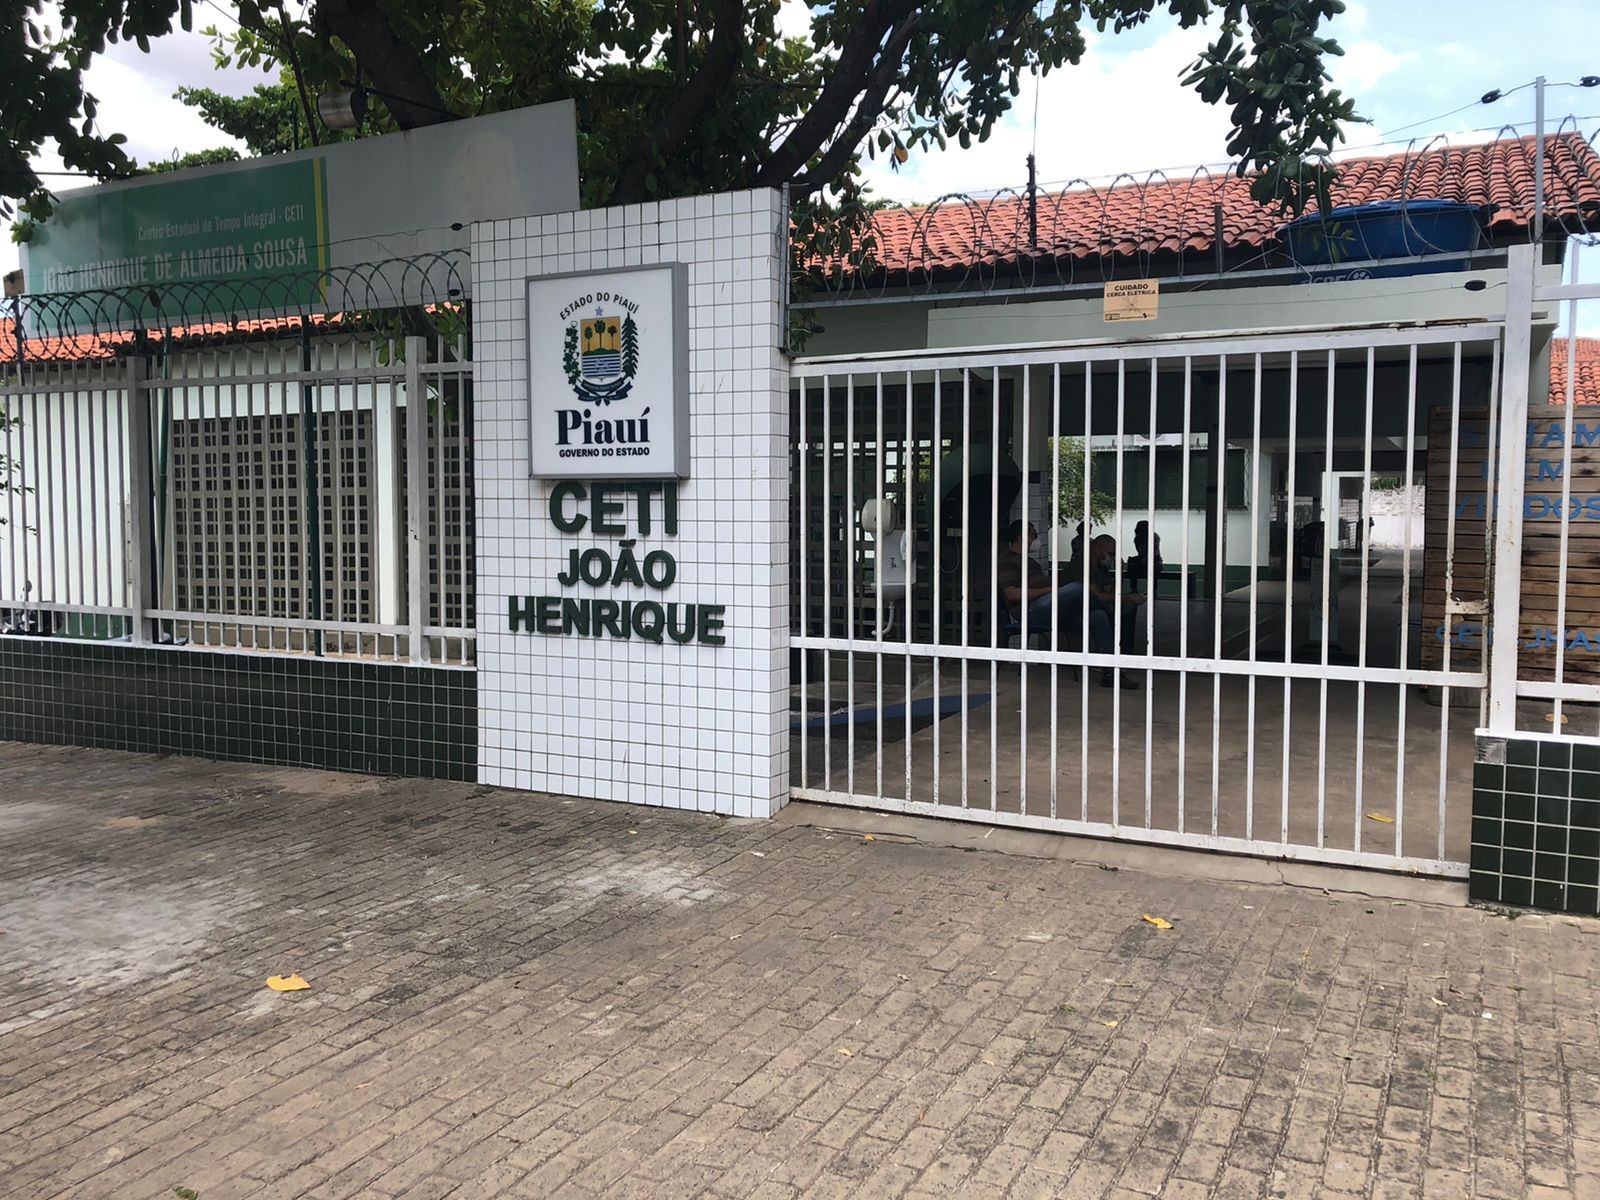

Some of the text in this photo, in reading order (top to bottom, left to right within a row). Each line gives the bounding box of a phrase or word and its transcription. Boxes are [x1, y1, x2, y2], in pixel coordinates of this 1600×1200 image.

[138, 226, 164, 241] Centro
[166, 218, 200, 237] Estadual
[202, 216, 213, 232] de
[215, 213, 241, 232] Tempo
[243, 208, 276, 229] Integral
[284, 204, 304, 222] CETI
[43, 236, 308, 293] JOÃO HENRIQUE DE ALMEIDA SOUSA
[560, 292, 639, 320] ESTADO DO PIAUÍ
[1114, 283, 1149, 292] CUIDADO
[1127, 289, 1157, 297] ELETRICA
[554, 406, 651, 446] Piauí
[559, 446, 650, 458] GOVERNO DO ESTADO
[549, 480, 678, 536] CETI
[1455, 495, 1600, 520] IDOS
[557, 539, 677, 589] JOÃO
[508, 595, 726, 645] HENRIQUE
